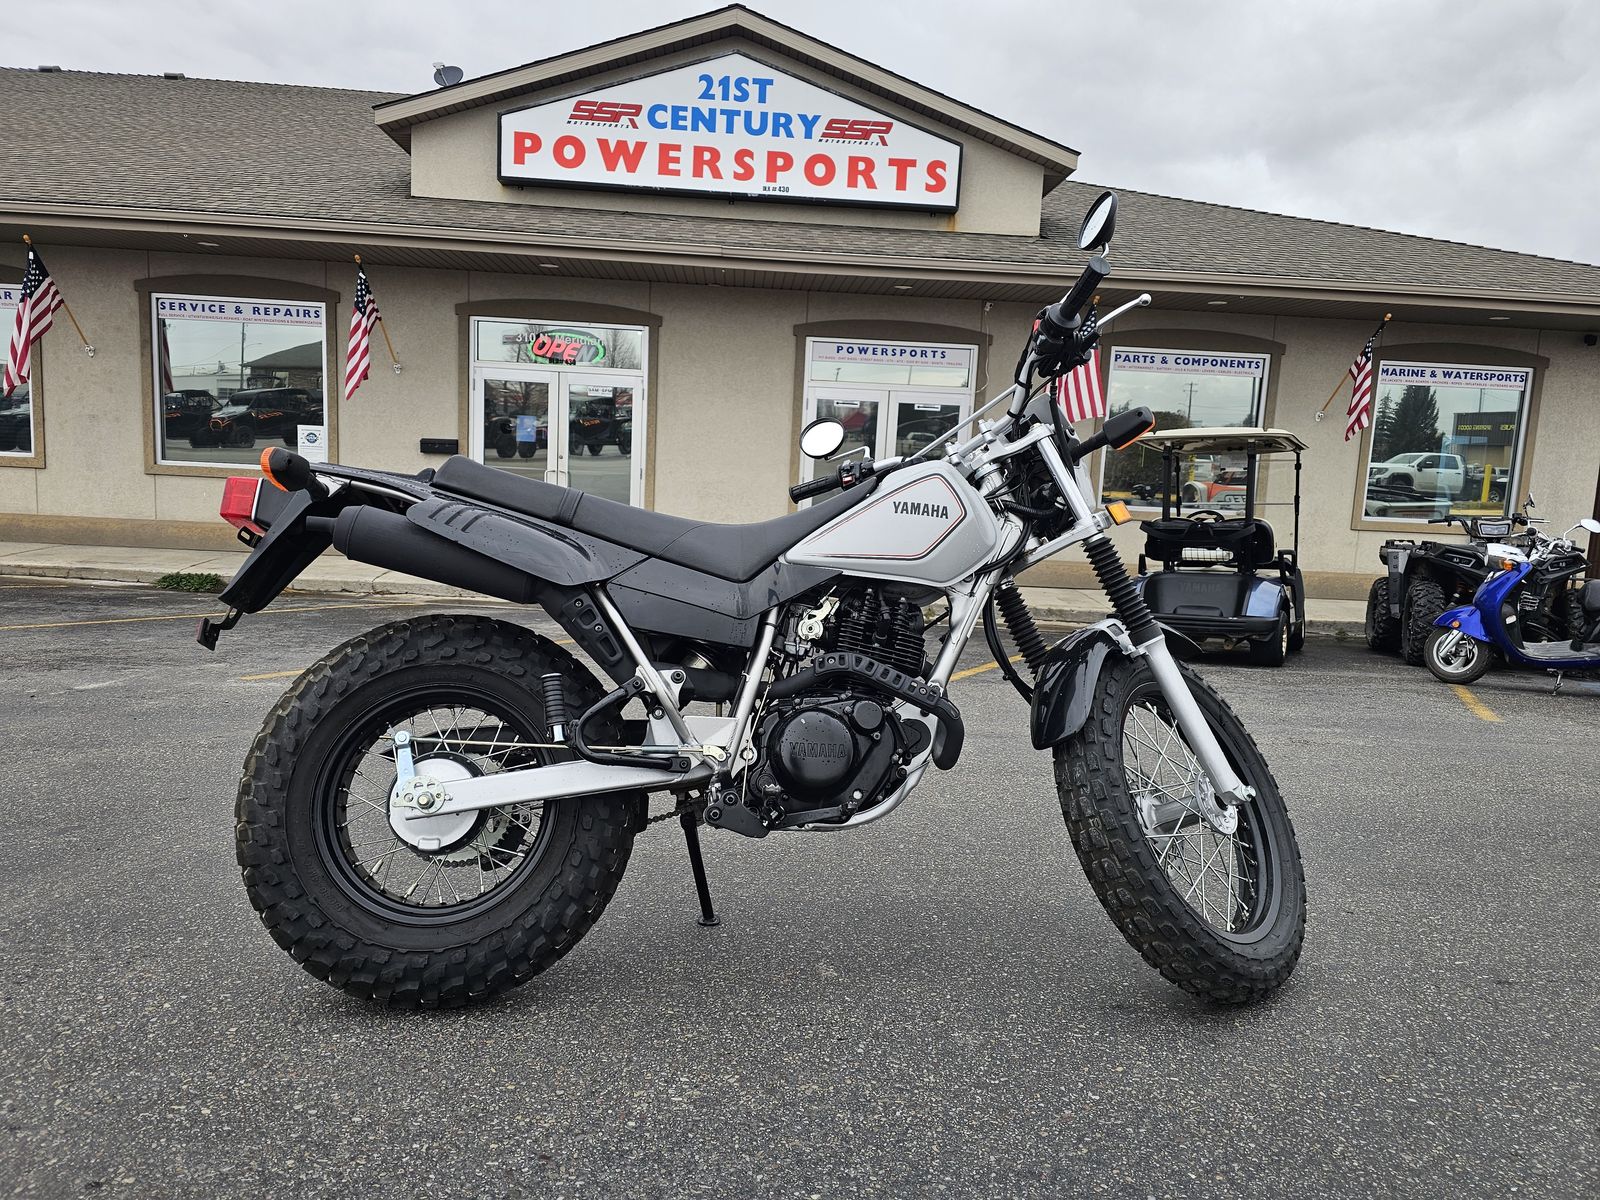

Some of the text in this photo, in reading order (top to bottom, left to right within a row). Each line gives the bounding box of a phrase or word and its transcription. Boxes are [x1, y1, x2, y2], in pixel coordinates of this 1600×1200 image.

[698, 74, 774, 103] 21ST
[568, 100, 642, 129] SSR
[647, 104, 821, 139] CENTURY
[567, 121, 630, 129] MOTORSPORTS
[821, 119, 893, 146] SSR
[513, 131, 947, 193] POWERSPORTS
[160, 302, 320, 318] SERVICE & REPAIRS
[516, 333, 537, 342] 310
[532, 336, 595, 364] OPEN
[836, 346, 946, 358] POWERSPORTS
[1114, 354, 1260, 369] PARTS & COMPONENTS
[1381, 368, 1524, 382] MARINE & WATERSPORTS
[893, 502, 948, 519] YAMAHA
[790, 742, 846, 758] YAMAHA
